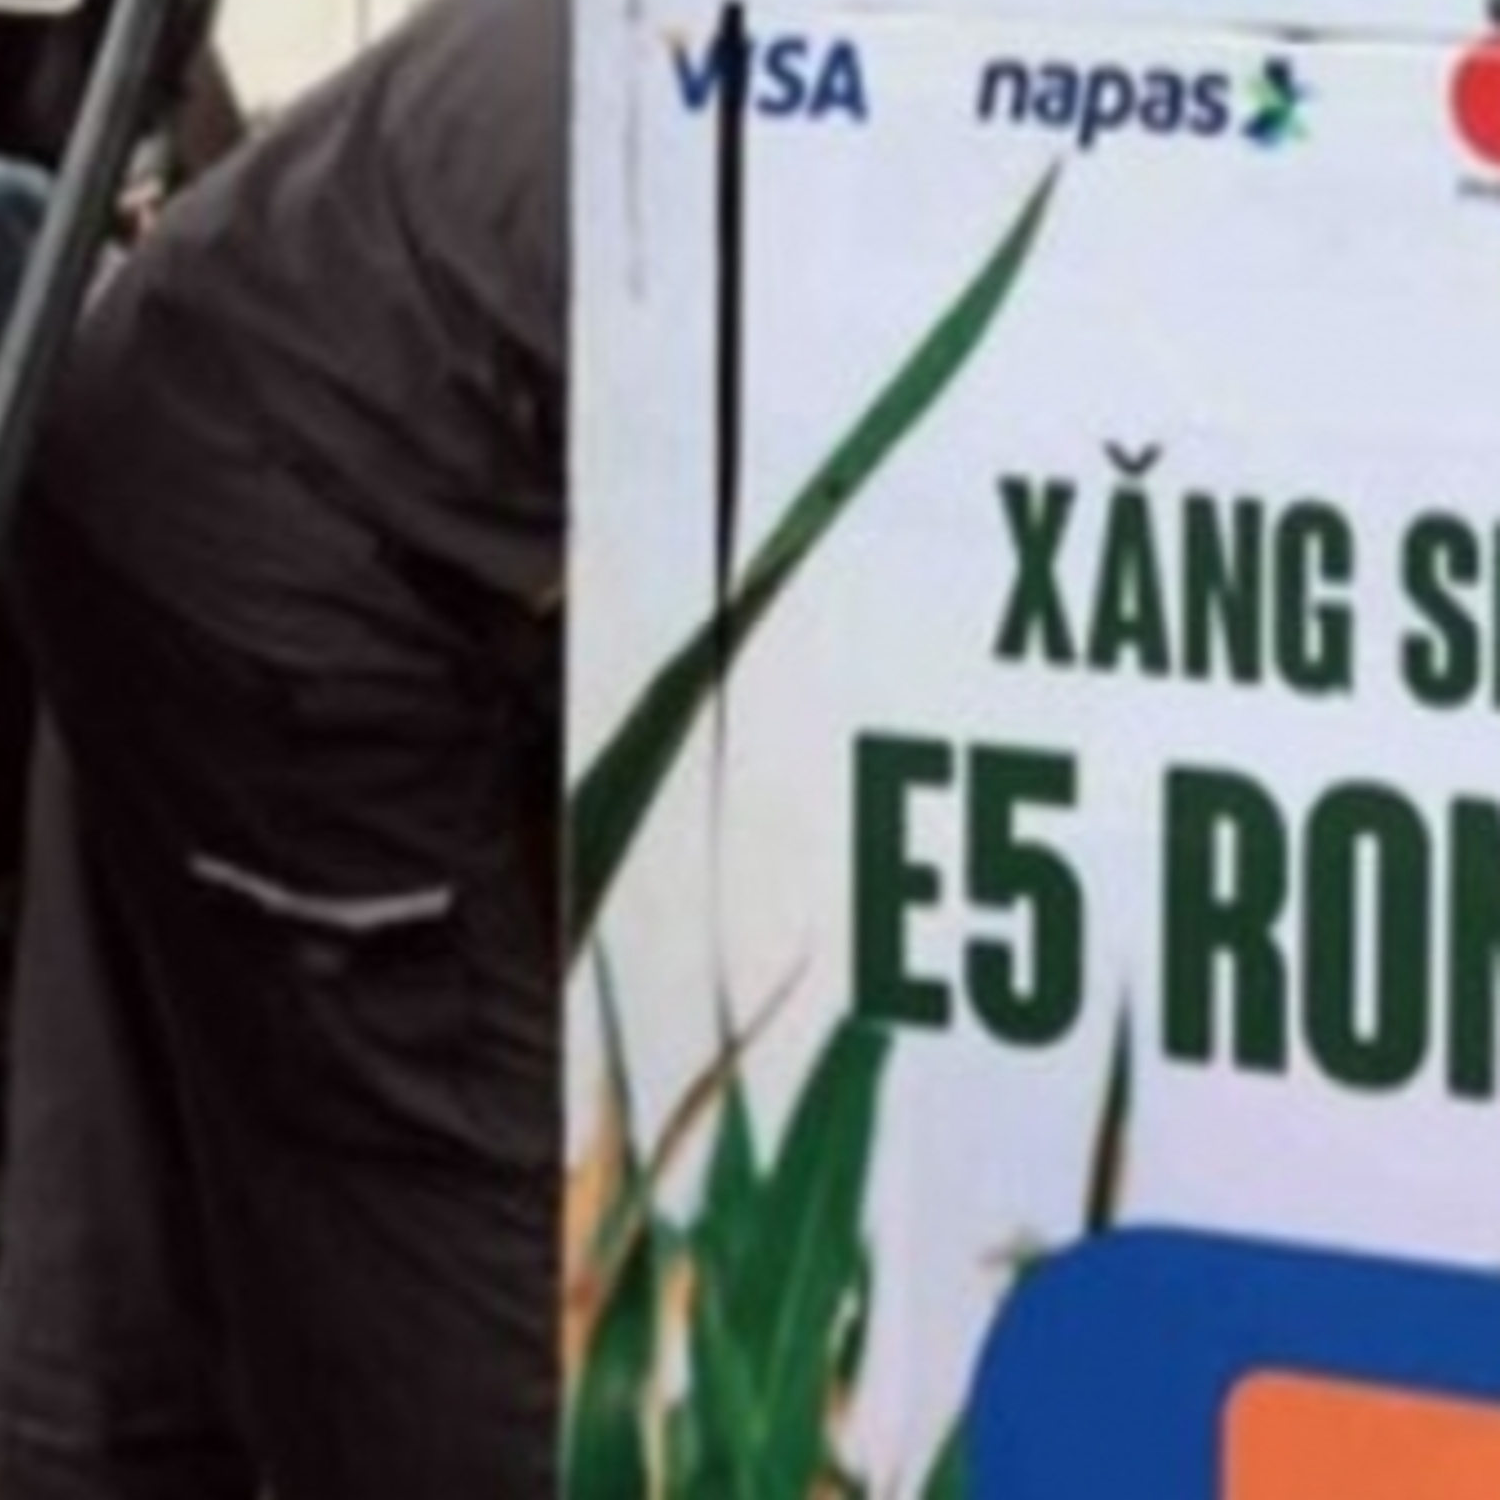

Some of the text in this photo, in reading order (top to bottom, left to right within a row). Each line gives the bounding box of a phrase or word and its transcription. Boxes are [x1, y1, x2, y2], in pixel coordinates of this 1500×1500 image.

[662, 30, 869, 124] VSA
[977, 56, 1231, 151] napas
[993, 440, 1500, 714] XĂNG S
[851, 730, 1086, 1050] E5
